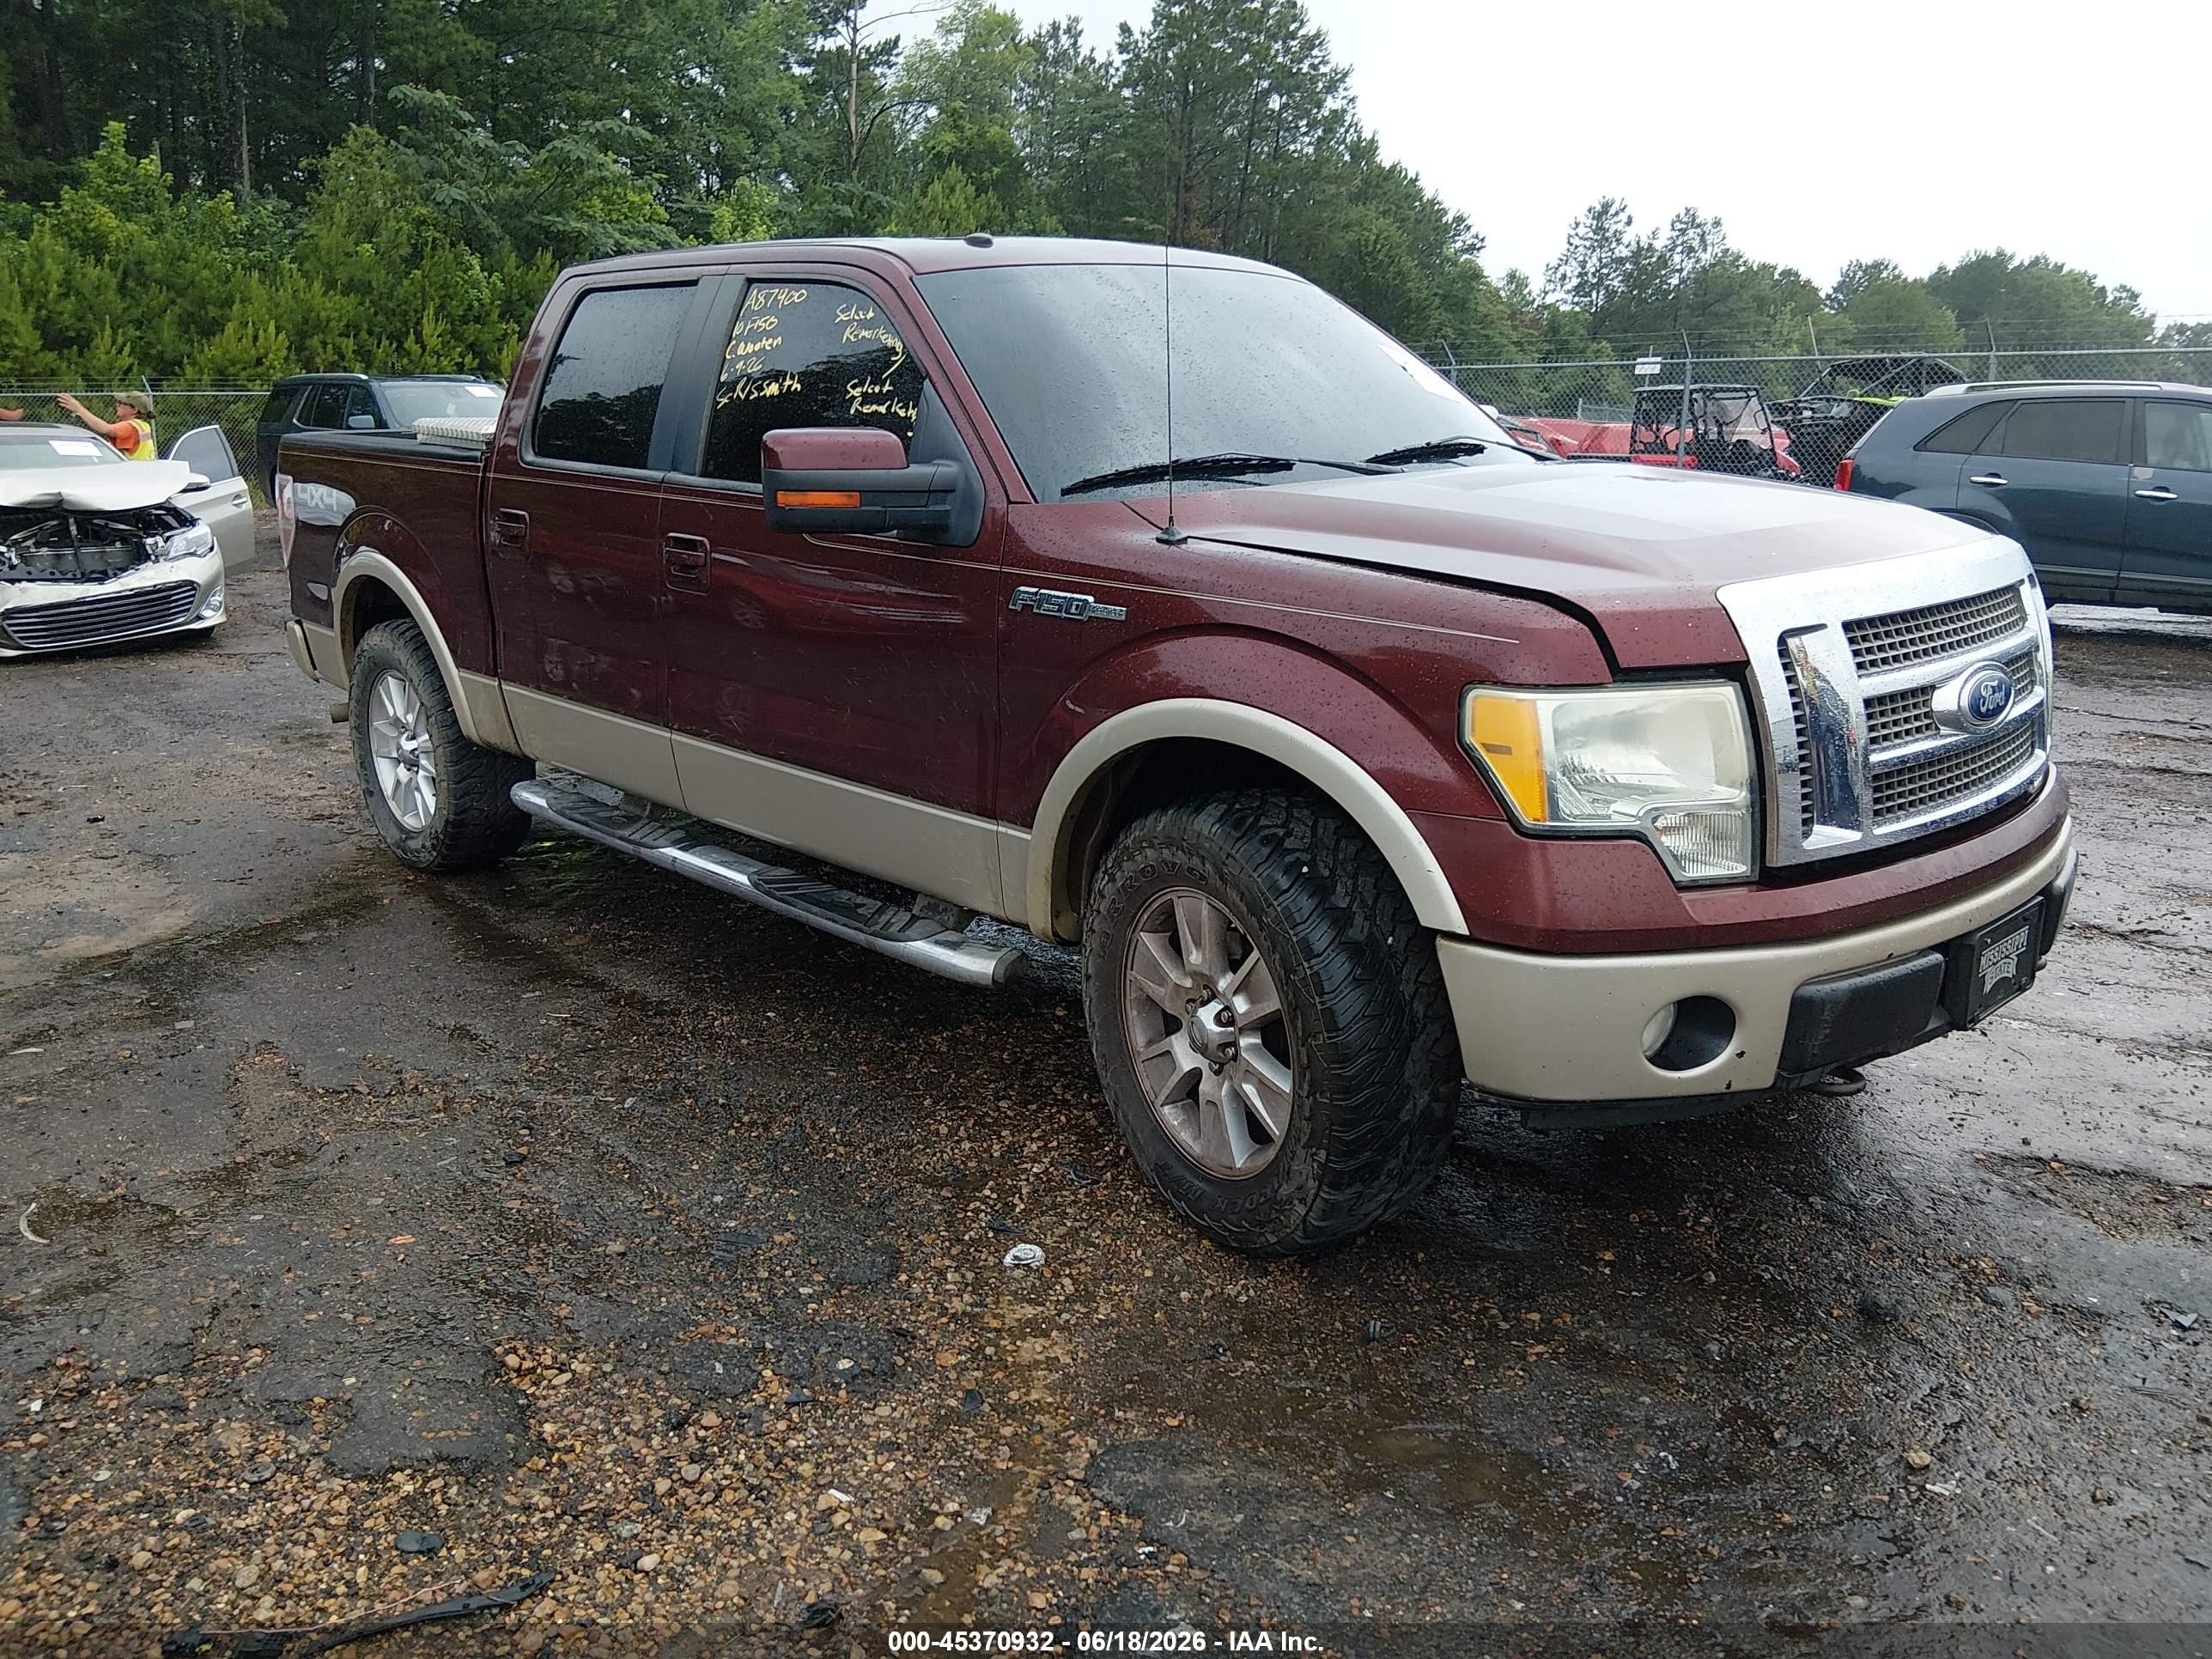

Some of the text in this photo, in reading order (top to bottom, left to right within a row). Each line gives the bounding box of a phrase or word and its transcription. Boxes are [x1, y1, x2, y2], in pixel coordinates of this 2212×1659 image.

[740, 288, 807, 317] A87400
[1979, 679, 2007, 714] Ford
[1978, 928, 2029, 973] MISSISSIPPI
[1988, 960, 2012, 987] STATE
